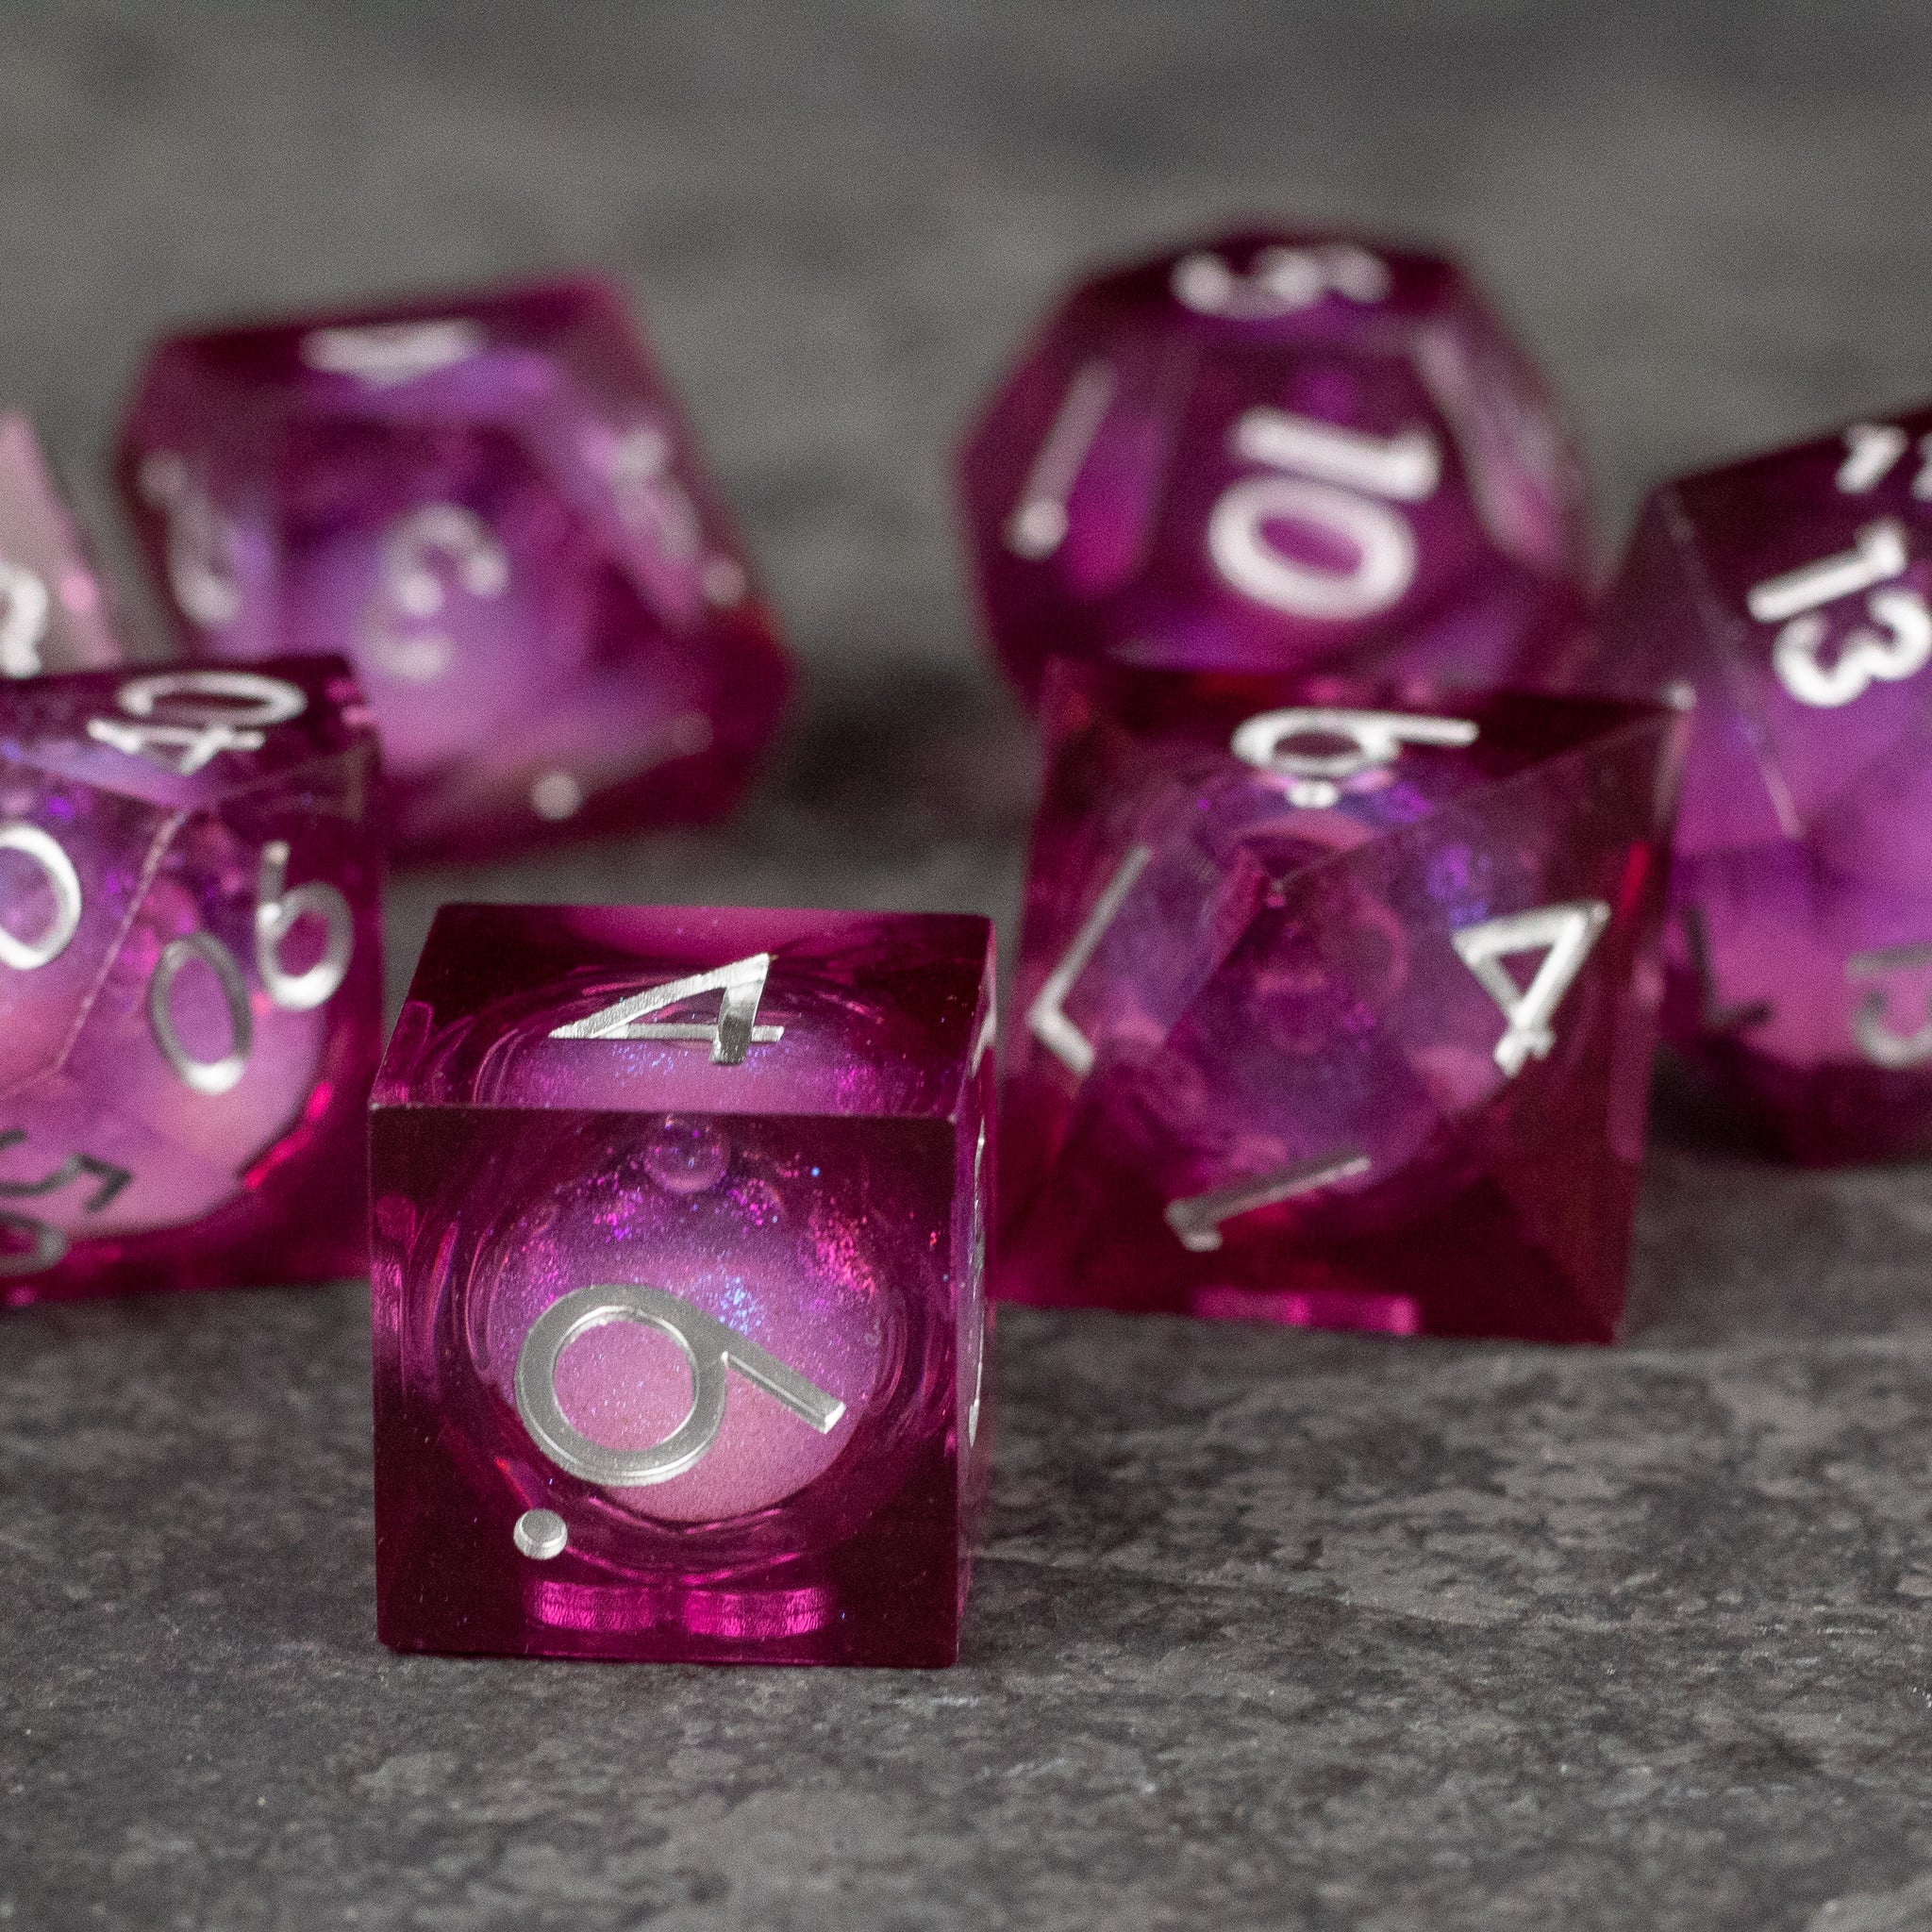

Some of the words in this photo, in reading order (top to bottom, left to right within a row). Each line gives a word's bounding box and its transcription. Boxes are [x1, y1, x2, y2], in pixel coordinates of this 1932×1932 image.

[1208, 404, 1441, 622] 10
[1748, 520, 1931, 708] 13
[88, 671, 307, 775] 40
[548, 953, 784, 1066] 4
[1451, 901, 1609, 1078] 4
